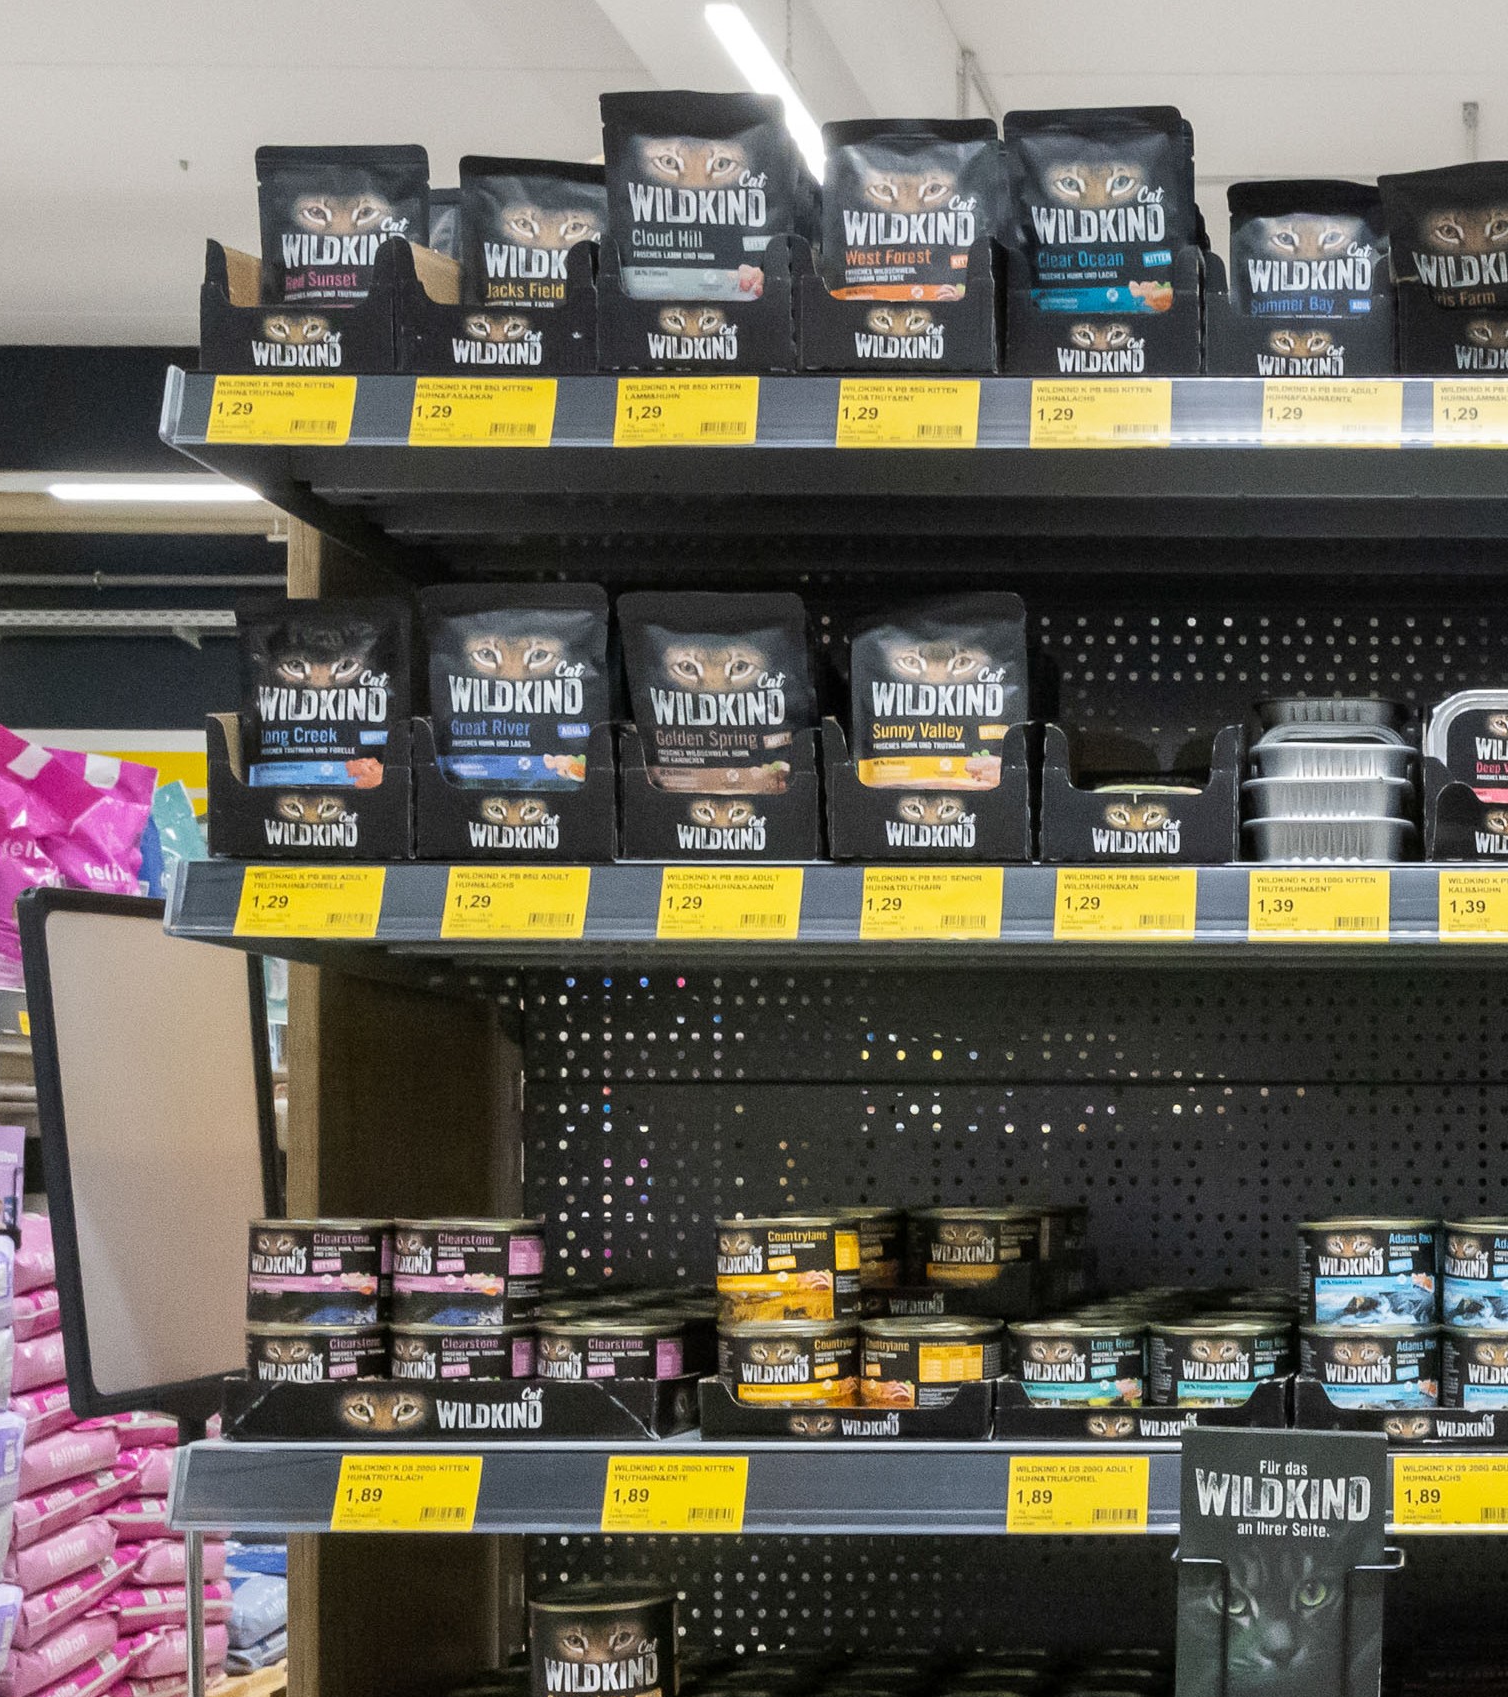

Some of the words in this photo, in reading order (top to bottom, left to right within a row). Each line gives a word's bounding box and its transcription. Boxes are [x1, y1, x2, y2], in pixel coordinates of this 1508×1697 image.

[629, 182, 766, 227] WILDKIND
[1032, 204, 1165, 245] WILDKIND
[632, 229, 673, 248] Cloud
[678, 231, 702, 248] Hill
[845, 249, 881, 267] West
[885, 247, 931, 266] Forest
[1038, 251, 1074, 268] Clear
[1078, 249, 1124, 268] Ocean
[626, 406, 662, 421] 1,29
[448, 675, 583, 714] WILDKIND
[872, 682, 1003, 717] WILDKIND
[294, 727, 337, 744] Creek
[450, 719, 488, 738] Great
[493, 718, 530, 737] River
[873, 722, 915, 741] Sunny
[920, 721, 963, 741] Valley
[655, 729, 702, 748] Golden
[706, 731, 757, 752] Spring
[1476, 762, 1499, 776] Deep
[865, 896, 902, 914] 1,29
[1449, 900, 1486, 915] 1,39
[313, 1234, 371, 1245] Clearstone
[767, 1230, 827, 1242] Countrylane
[437, 1396, 543, 1430] WILDKIND
[1260, 1459, 1280, 1476] Für
[1284, 1461, 1308, 1476] das
[344, 1486, 383, 1505] 1,89
[1195, 1469, 1371, 1522] WILDKIND
[1237, 1524, 1253, 1536] an
[1256, 1522, 1288, 1537] Ihrer
[1292, 1522, 1330, 1538] Seite.
